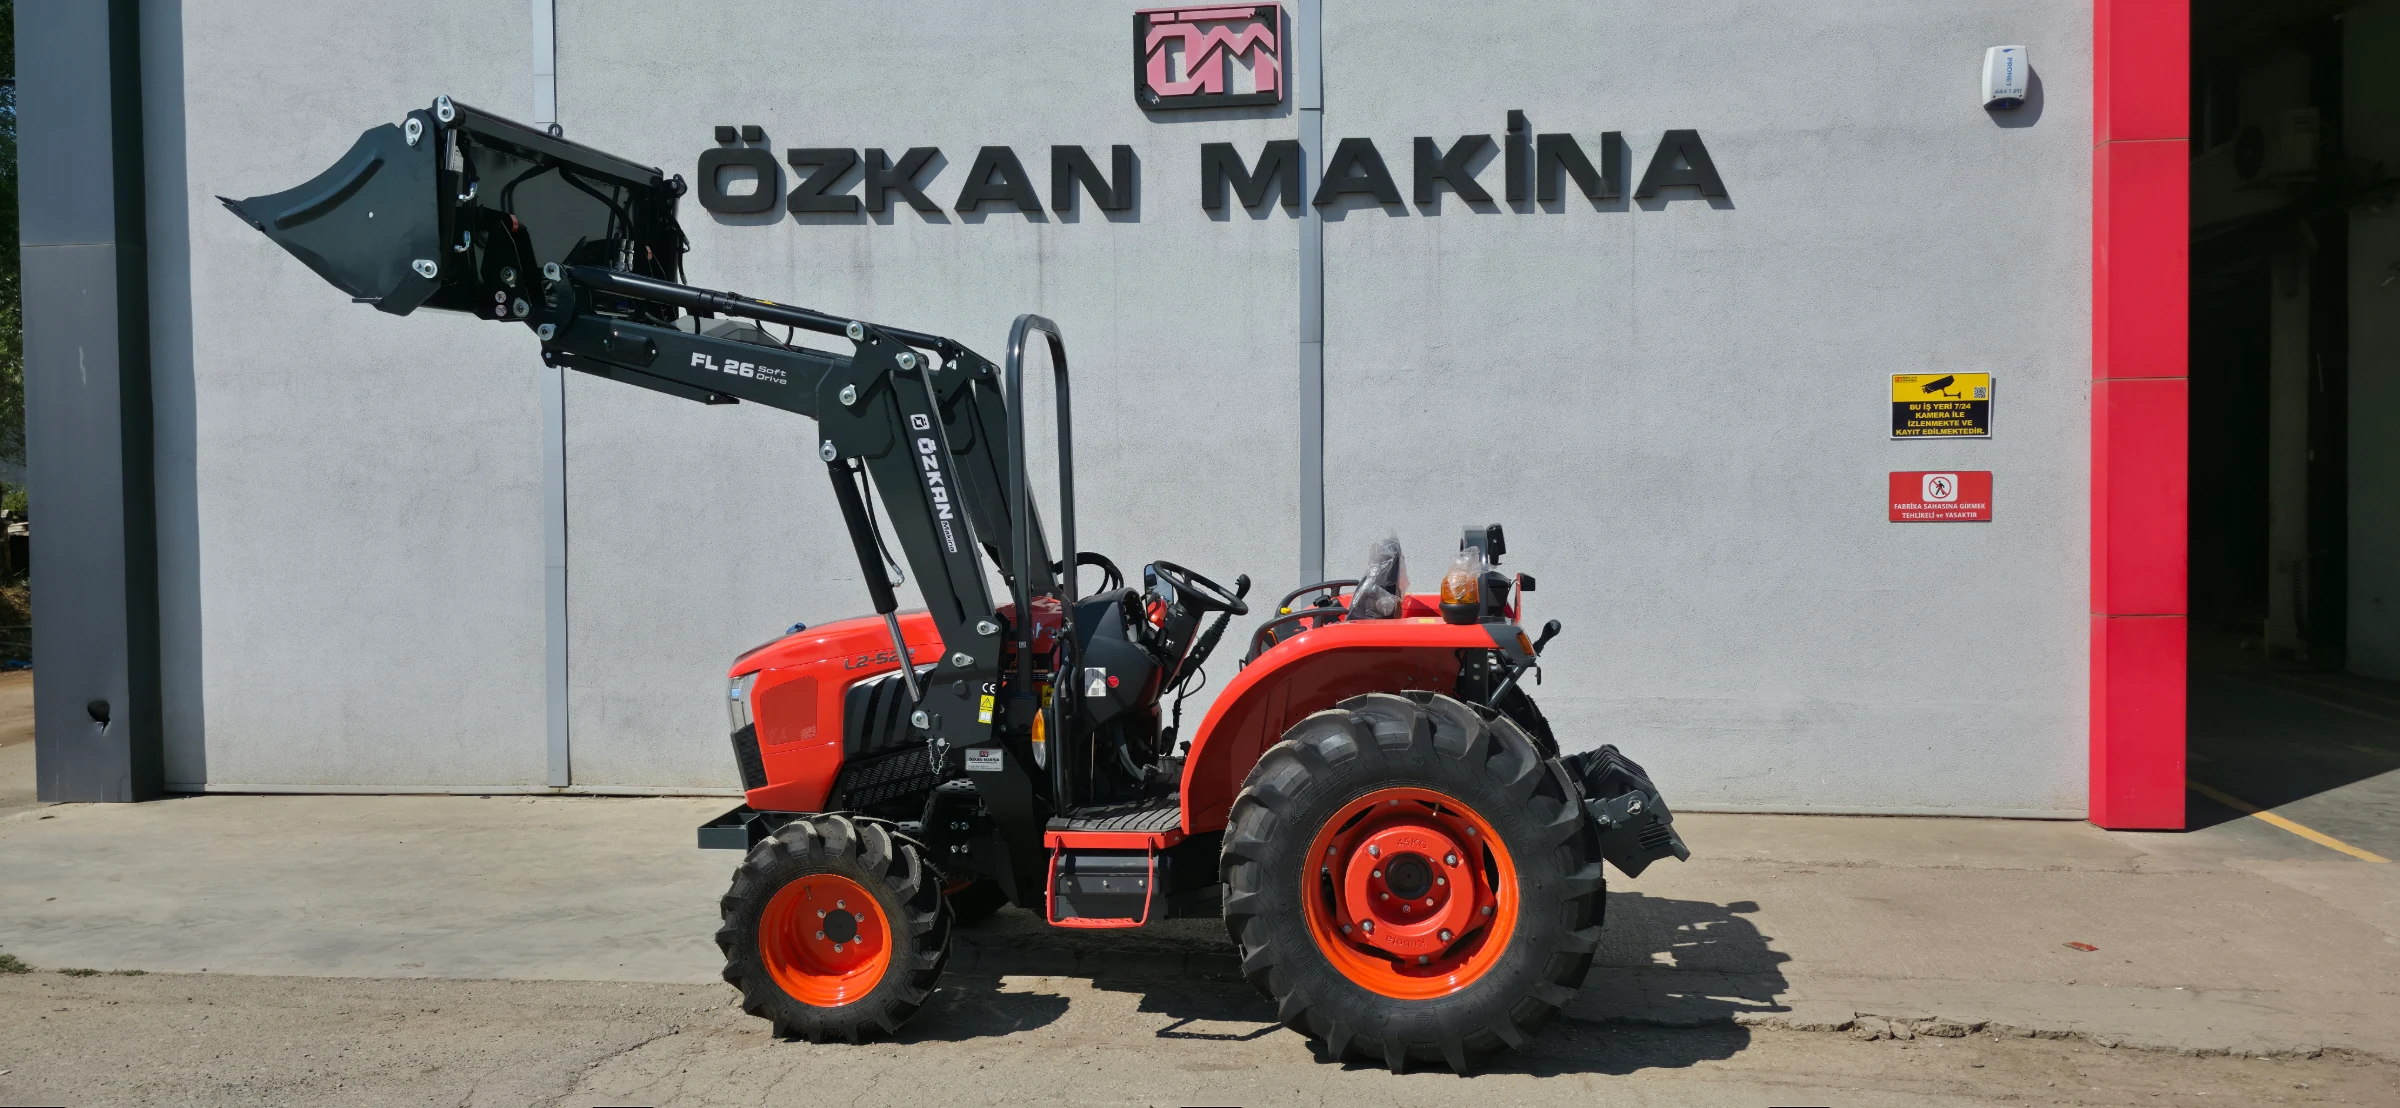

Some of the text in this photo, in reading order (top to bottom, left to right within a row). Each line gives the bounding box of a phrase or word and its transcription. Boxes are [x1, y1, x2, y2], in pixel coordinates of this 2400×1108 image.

[697, 109, 1728, 214] ÖZKAN MAKİNA
[691, 352, 755, 378] FL 26
[757, 365, 787, 377] Soft
[756, 373, 787, 385] Drive
[1923, 402, 1932, 411] İŞ
[1933, 402, 1952, 410] YERİ
[1915, 410, 1965, 419] KAMERA İLE
[1907, 419, 1960, 427] İZLENMEKTE
[1922, 427, 1985, 435] EDİLMEKTEDİR.
[917, 437, 954, 520] ÖZKAN
[1894, 502, 1922, 510] FABRİKA
[1959, 501, 1986, 509] GİRMEK
[1902, 511, 1935, 519] TEHLİKELİ
[941, 520, 957, 553] Makina
[982, 682, 996, 694] CE
[1397, 837, 1428, 850] 45KG
